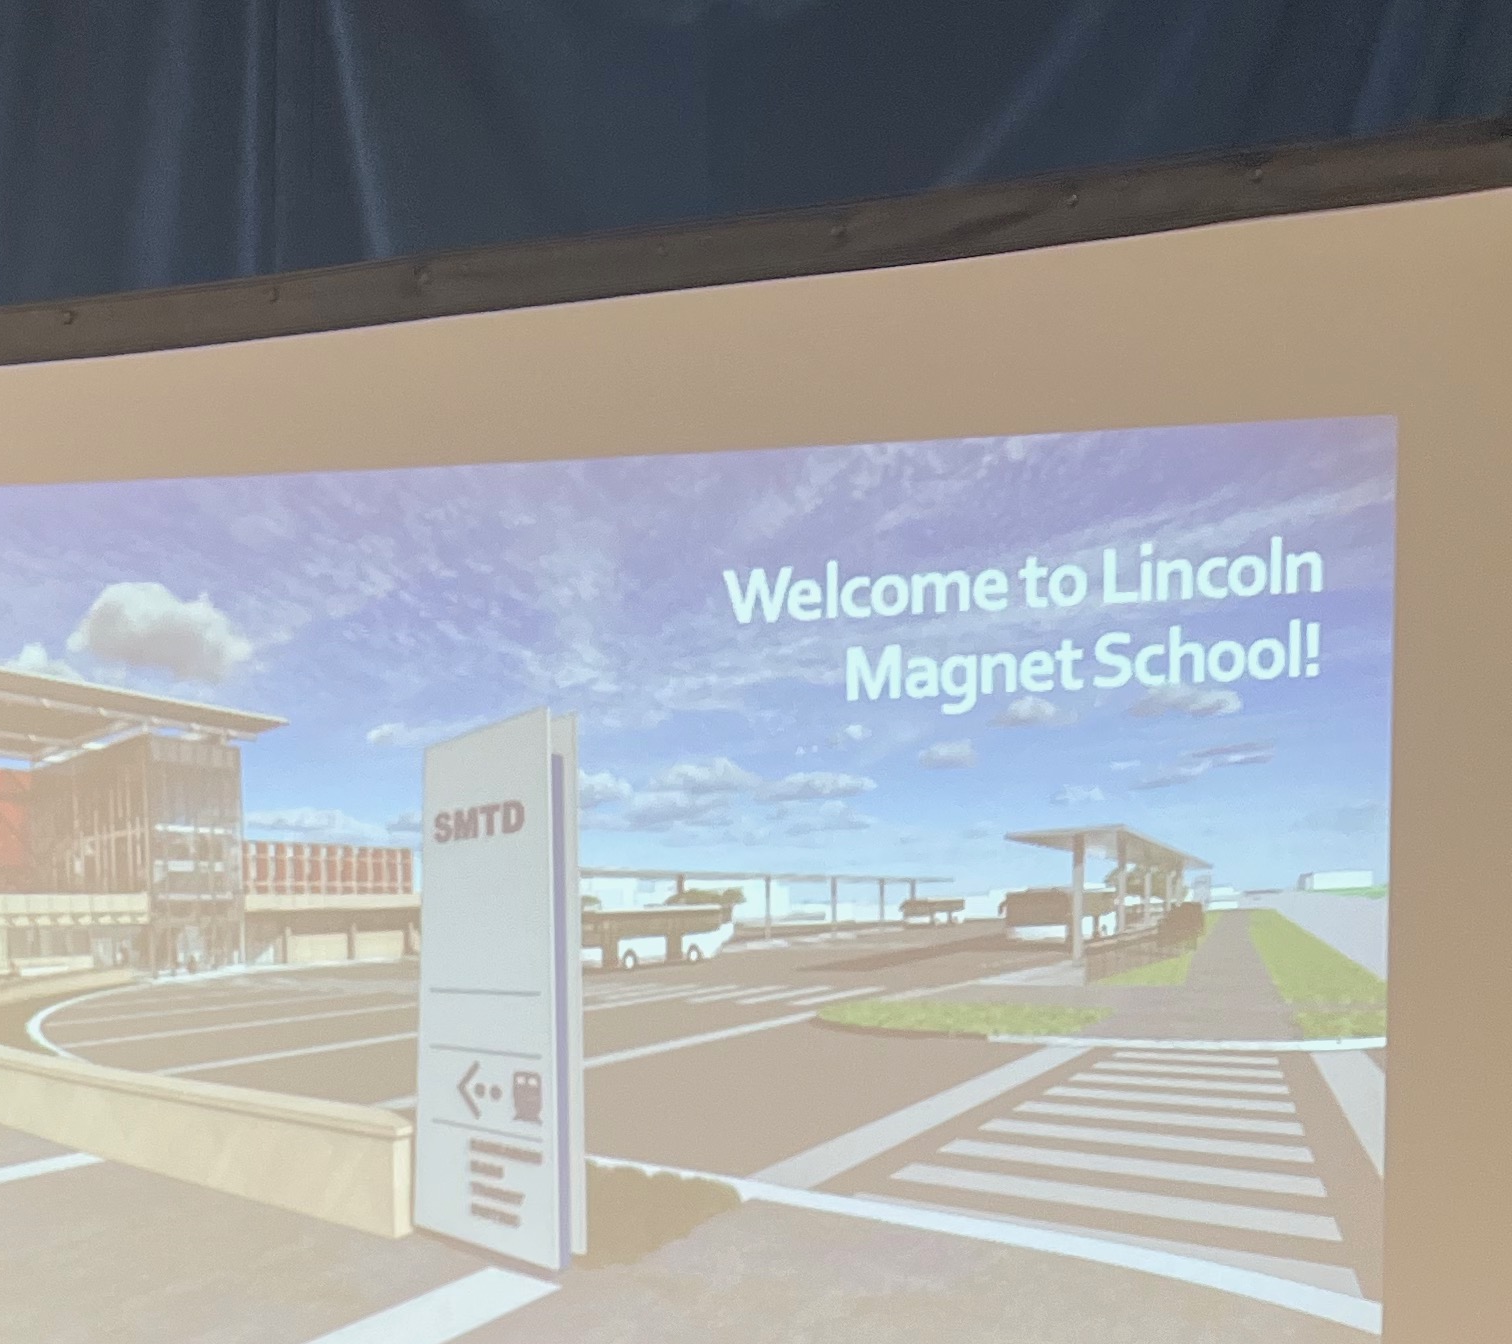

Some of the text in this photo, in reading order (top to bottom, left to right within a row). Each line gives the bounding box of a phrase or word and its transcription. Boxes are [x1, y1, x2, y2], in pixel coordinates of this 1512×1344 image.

[723, 536, 1323, 624] Welcome to Lincoln
[845, 620, 1321, 715] Magnet School!
[434, 799, 525, 843] SMTD
